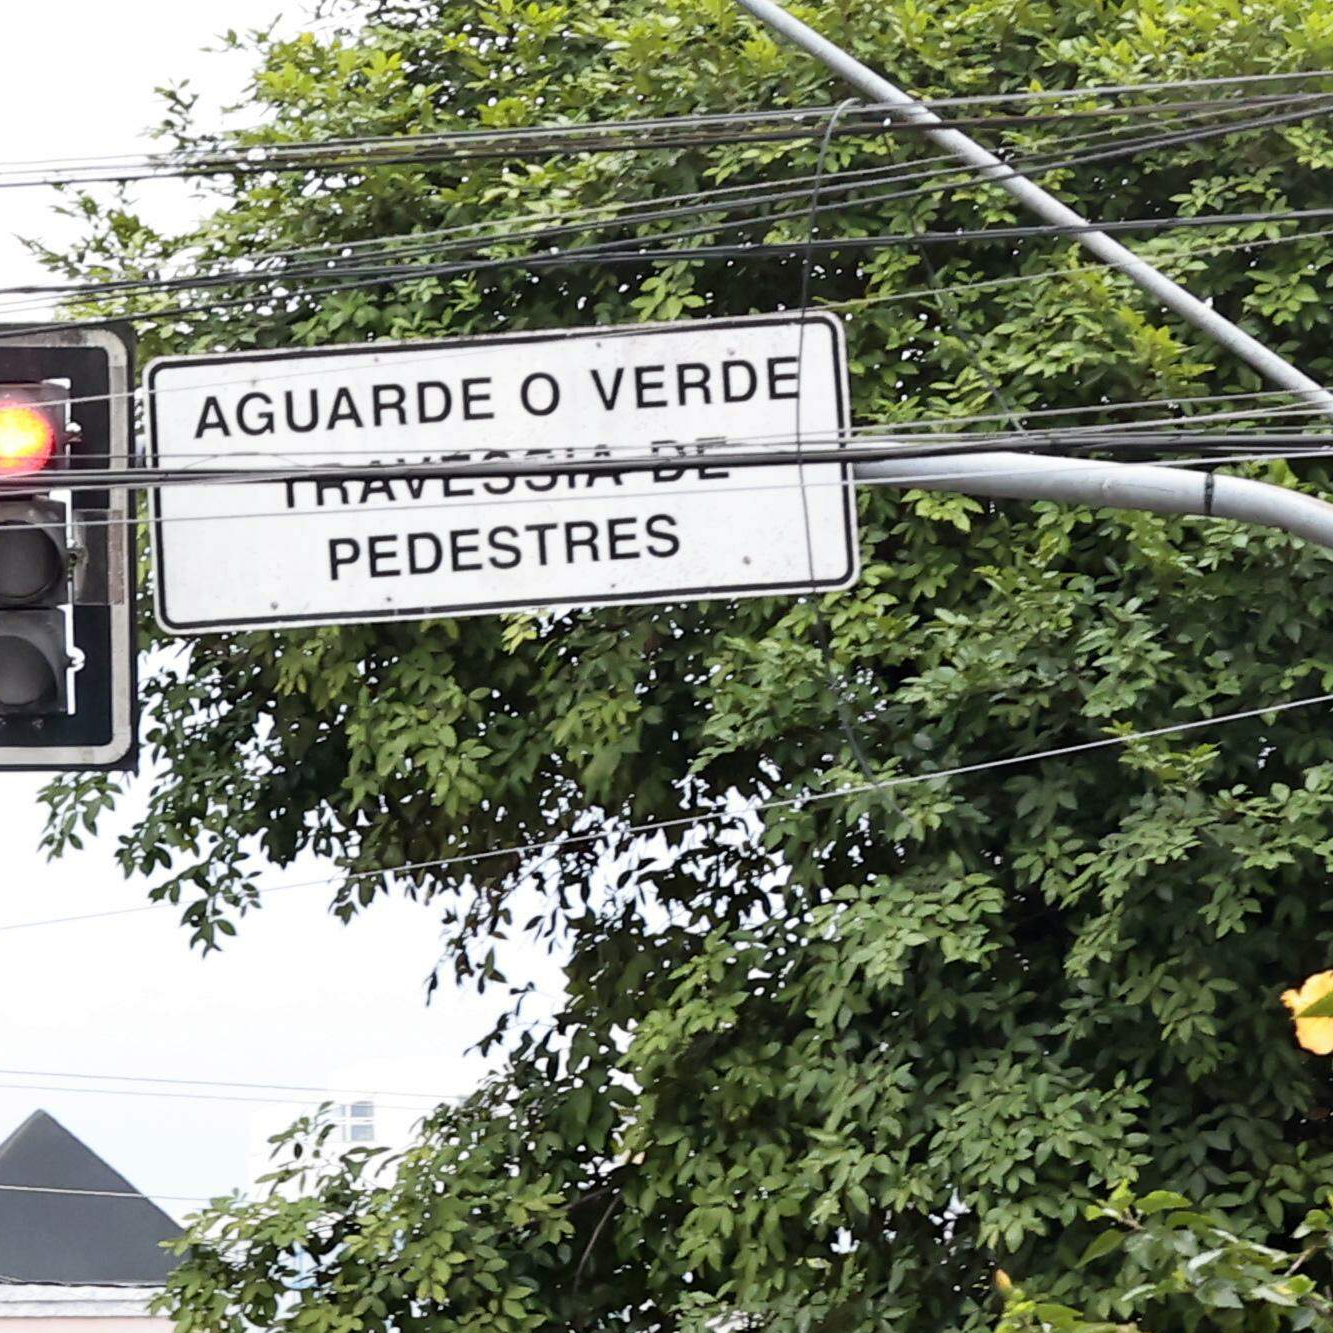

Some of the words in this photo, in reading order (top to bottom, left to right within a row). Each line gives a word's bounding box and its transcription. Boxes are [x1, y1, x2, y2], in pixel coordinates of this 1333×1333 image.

[195, 377, 494, 439] AGUARDE
[520, 372, 561, 417] O
[590, 356, 801, 412] VERDE
[328, 513, 681, 581] PEDESTRES
